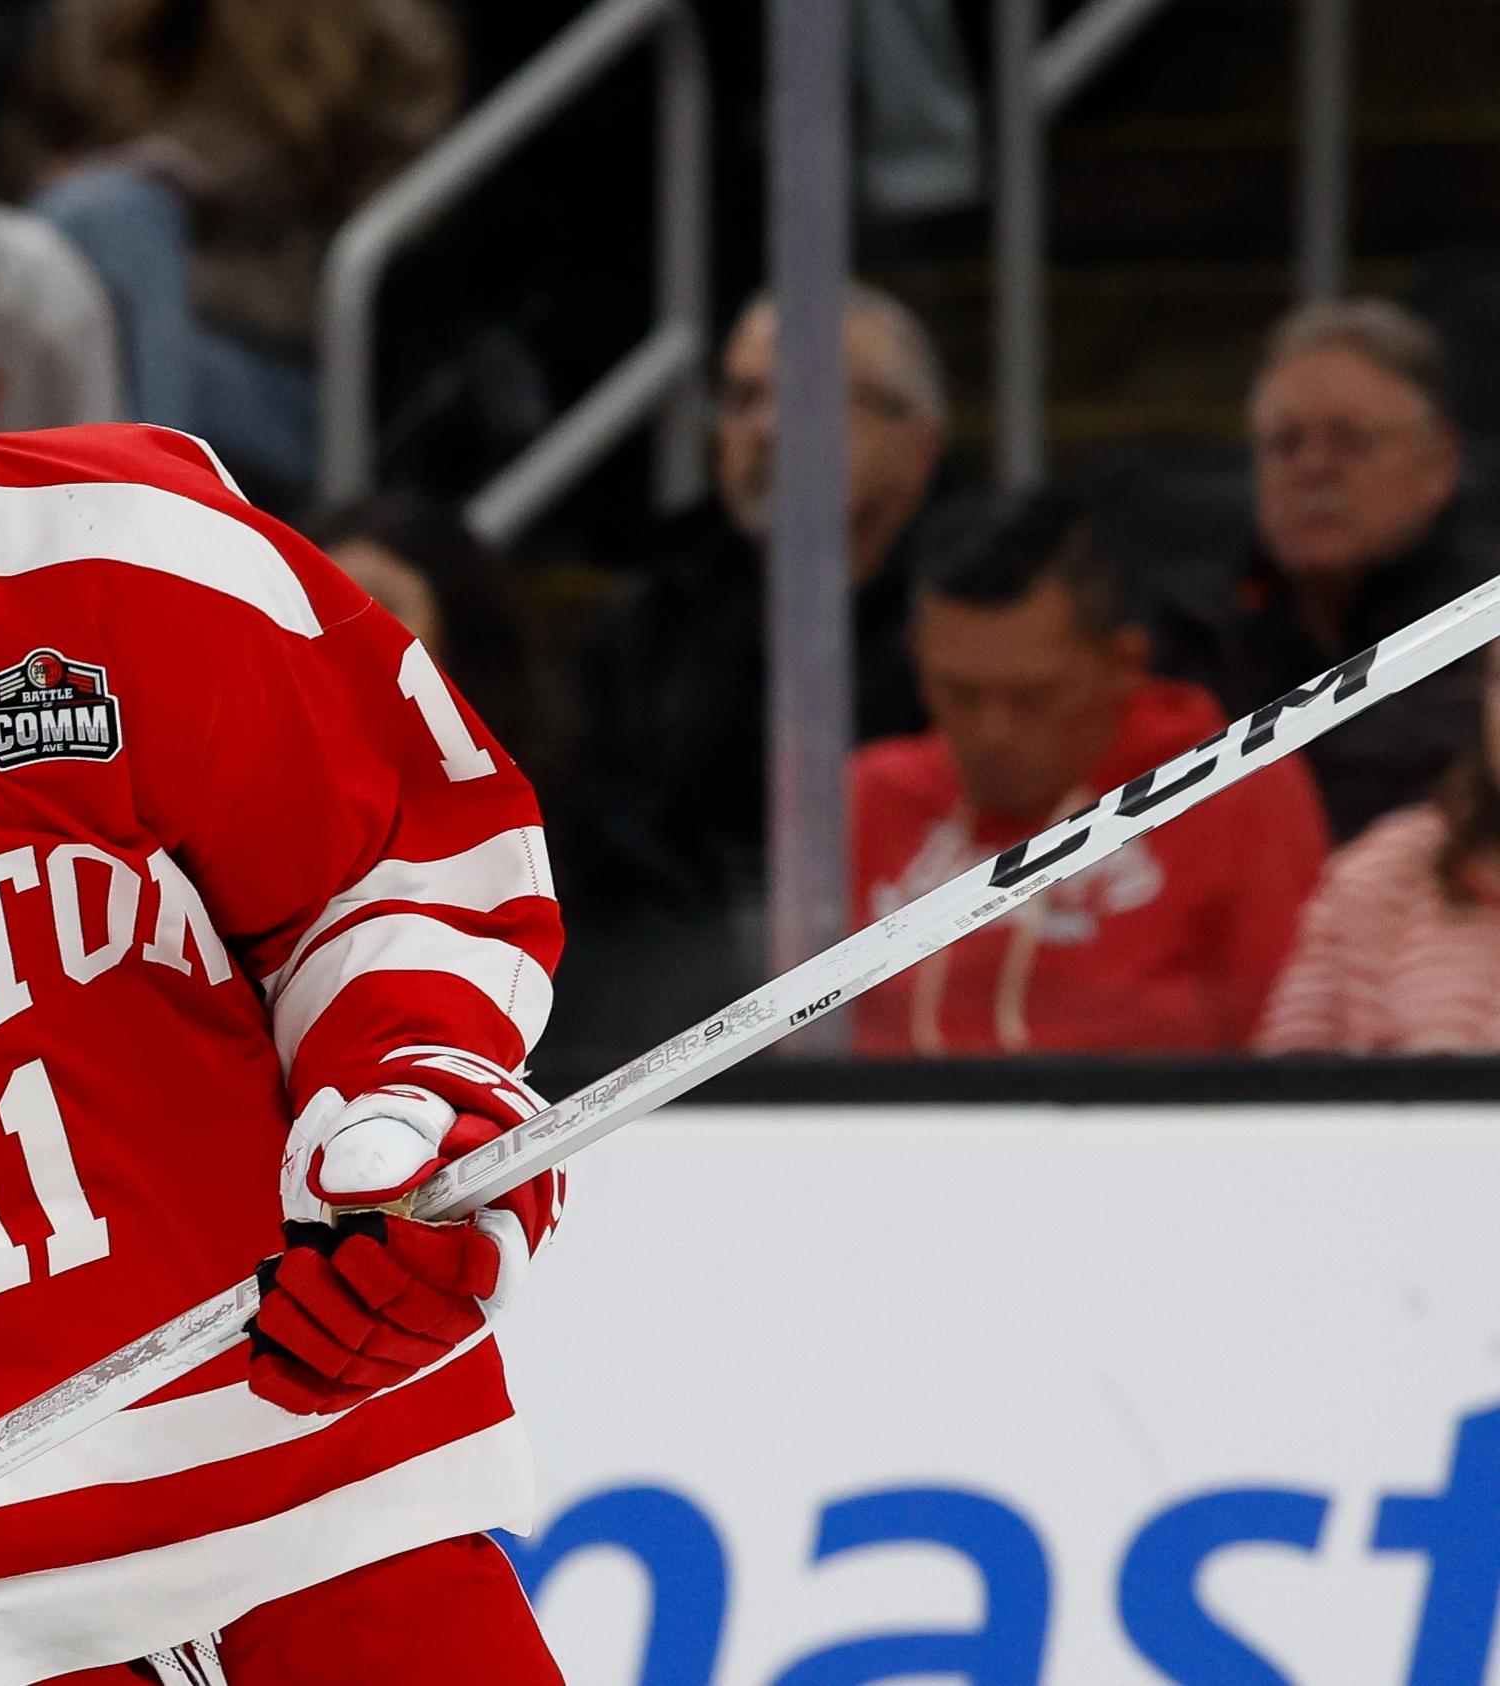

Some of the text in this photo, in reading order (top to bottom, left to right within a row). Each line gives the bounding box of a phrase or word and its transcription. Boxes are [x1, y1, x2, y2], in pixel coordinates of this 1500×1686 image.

[21, 687, 74, 704] BATTLE
[396, 636, 517, 783] 1
[41, 743, 65, 753] AVE
[987, 642, 1379, 891] CCM
[704, 1020, 725, 1042] 9
